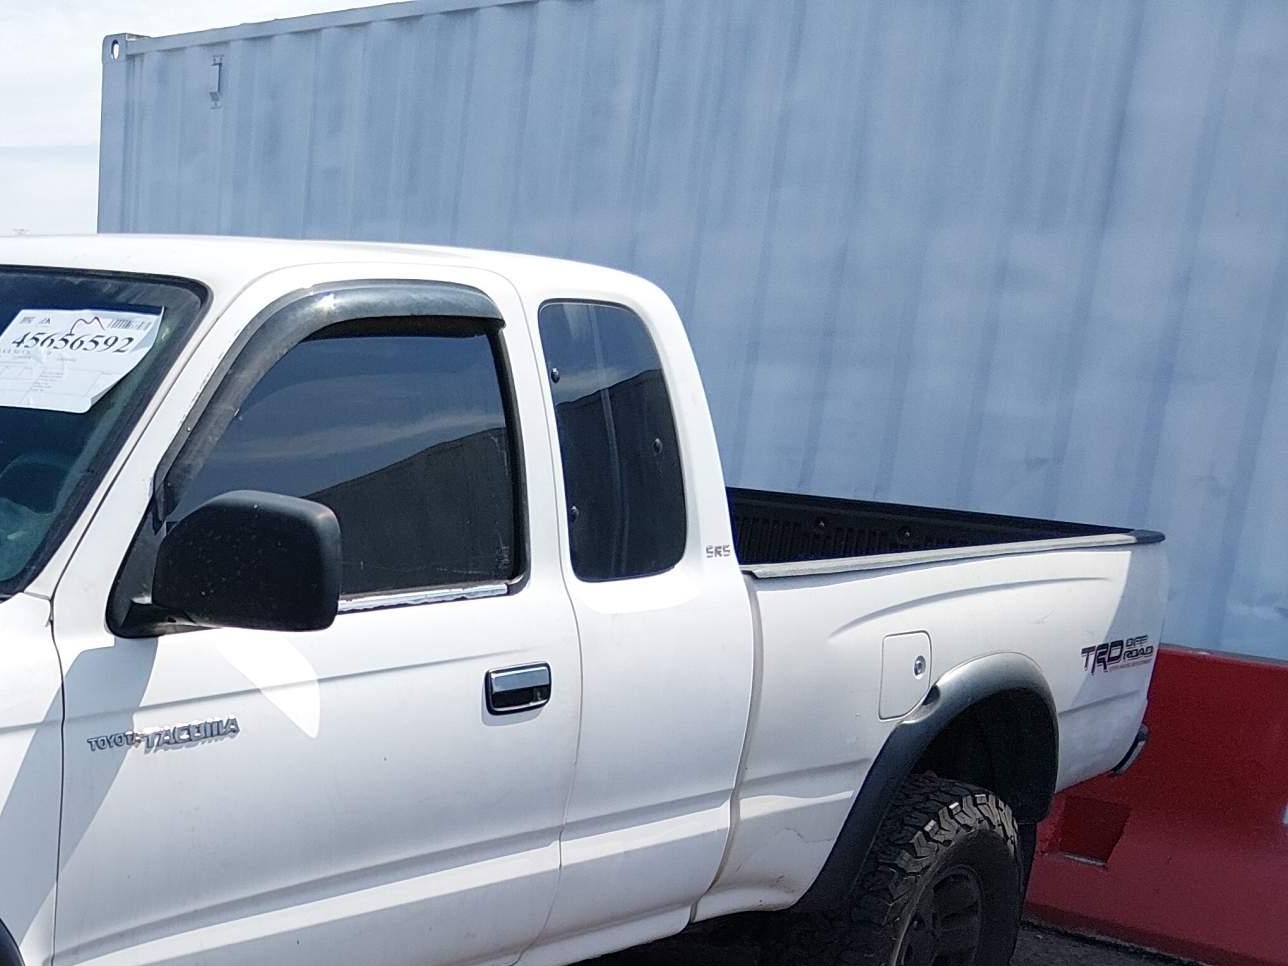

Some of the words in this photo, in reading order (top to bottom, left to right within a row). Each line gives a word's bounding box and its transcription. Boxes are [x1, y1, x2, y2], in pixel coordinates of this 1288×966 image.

[11, 331, 135, 353] 45656592
[1126, 634, 1149, 648] OFF
[1081, 640, 1124, 674] TRD
[1123, 645, 1154, 660] ROAD
[87, 732, 143, 751] TOYOTA
[142, 717, 240, 749] TACOMA
